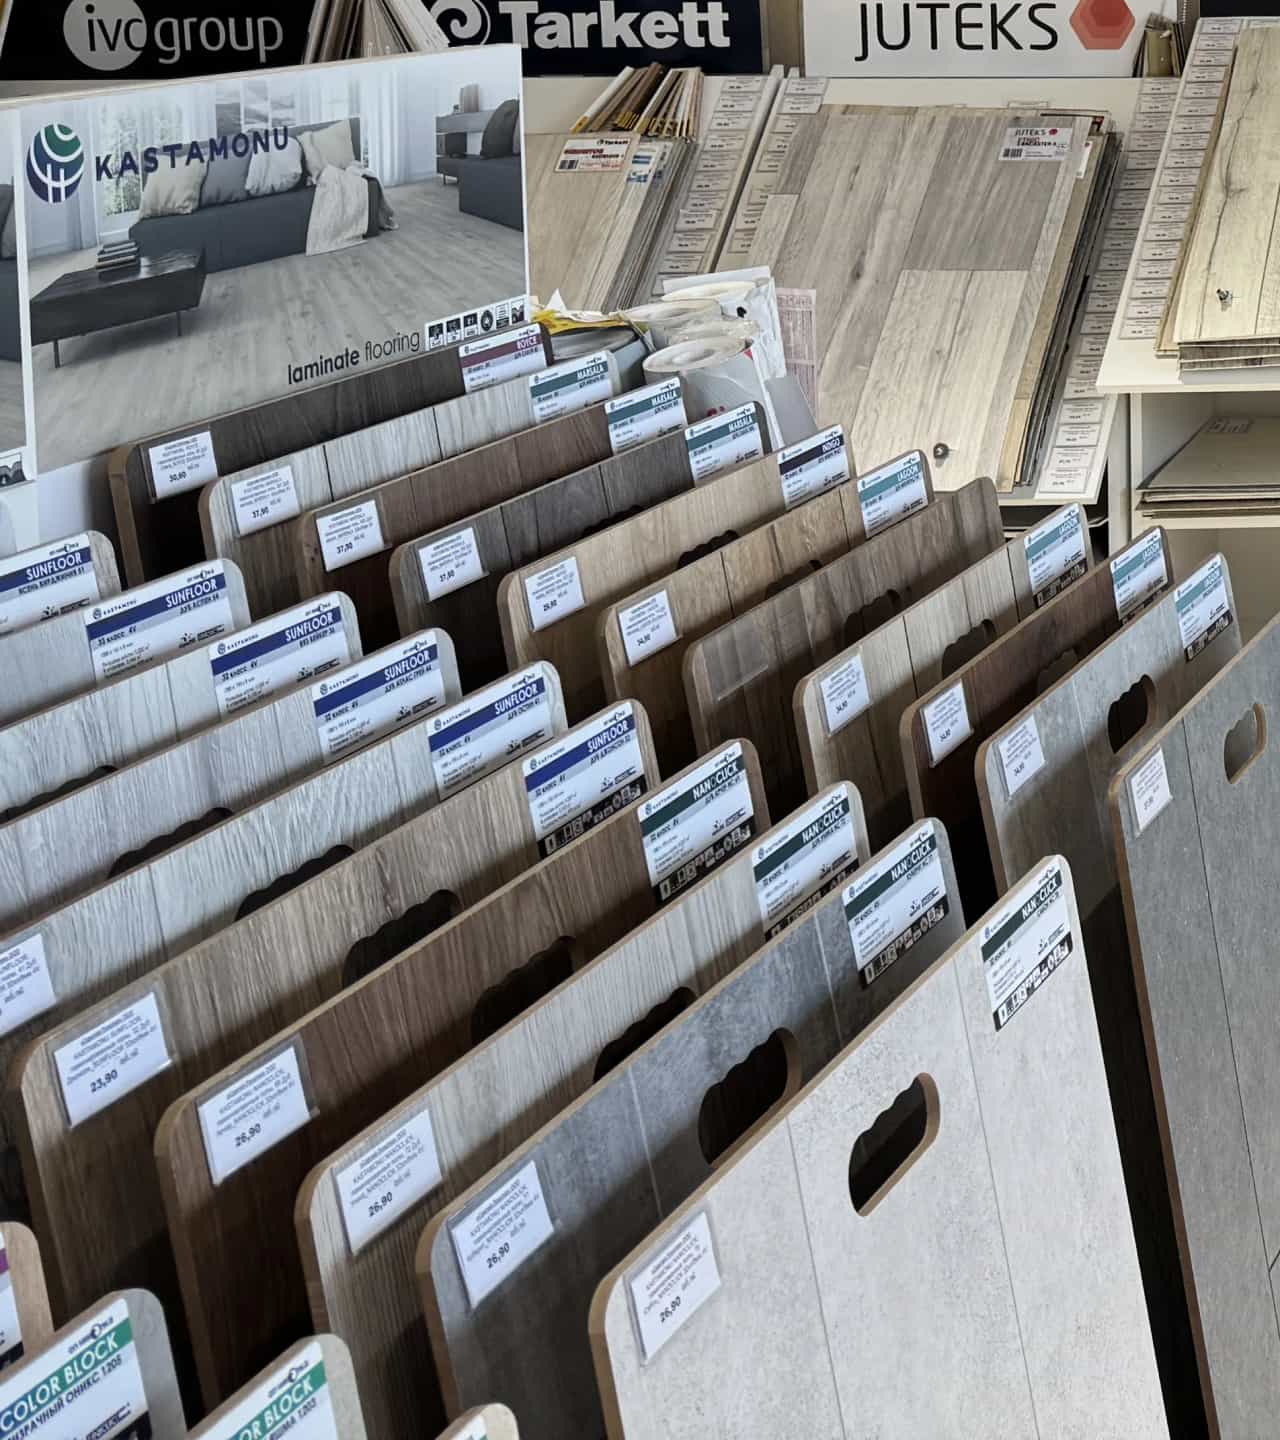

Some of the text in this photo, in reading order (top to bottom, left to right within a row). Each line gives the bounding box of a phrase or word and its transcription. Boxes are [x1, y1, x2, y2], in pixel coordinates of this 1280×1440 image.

[499, 1, 731, 49] Tarkett
[853, 2, 1059, 62] JUTEKS
[95, 125, 291, 182] KASTAMONU
[286, 330, 421, 385] laminate flooring
[728, 415, 754, 433] MARSALA
[896, 465, 920, 482] LAGOON
[25, 551, 82, 581] SUNFLOOR
[164, 579, 218, 608] SUNFLOOR
[284, 611, 334, 642] SUNFLOOR
[384, 650, 431, 681] SUNFLOOR
[494, 683, 538, 715] SUNFLOOR
[586, 719, 628, 752] SUNFLOOR
[692, 762, 738, 800] NANOCLICK
[800, 805, 845, 844] NANOCLICK
[890, 838, 932, 882] NANOCLICK
[1020, 878, 1058, 921] NANOCLICK
[0, 1330, 119, 1433] COLOR BLOCK
[5, 1396, 65, 1440] ИЗРАЧНЫЙ
[264, 1376, 314, 1430] BLOCK
